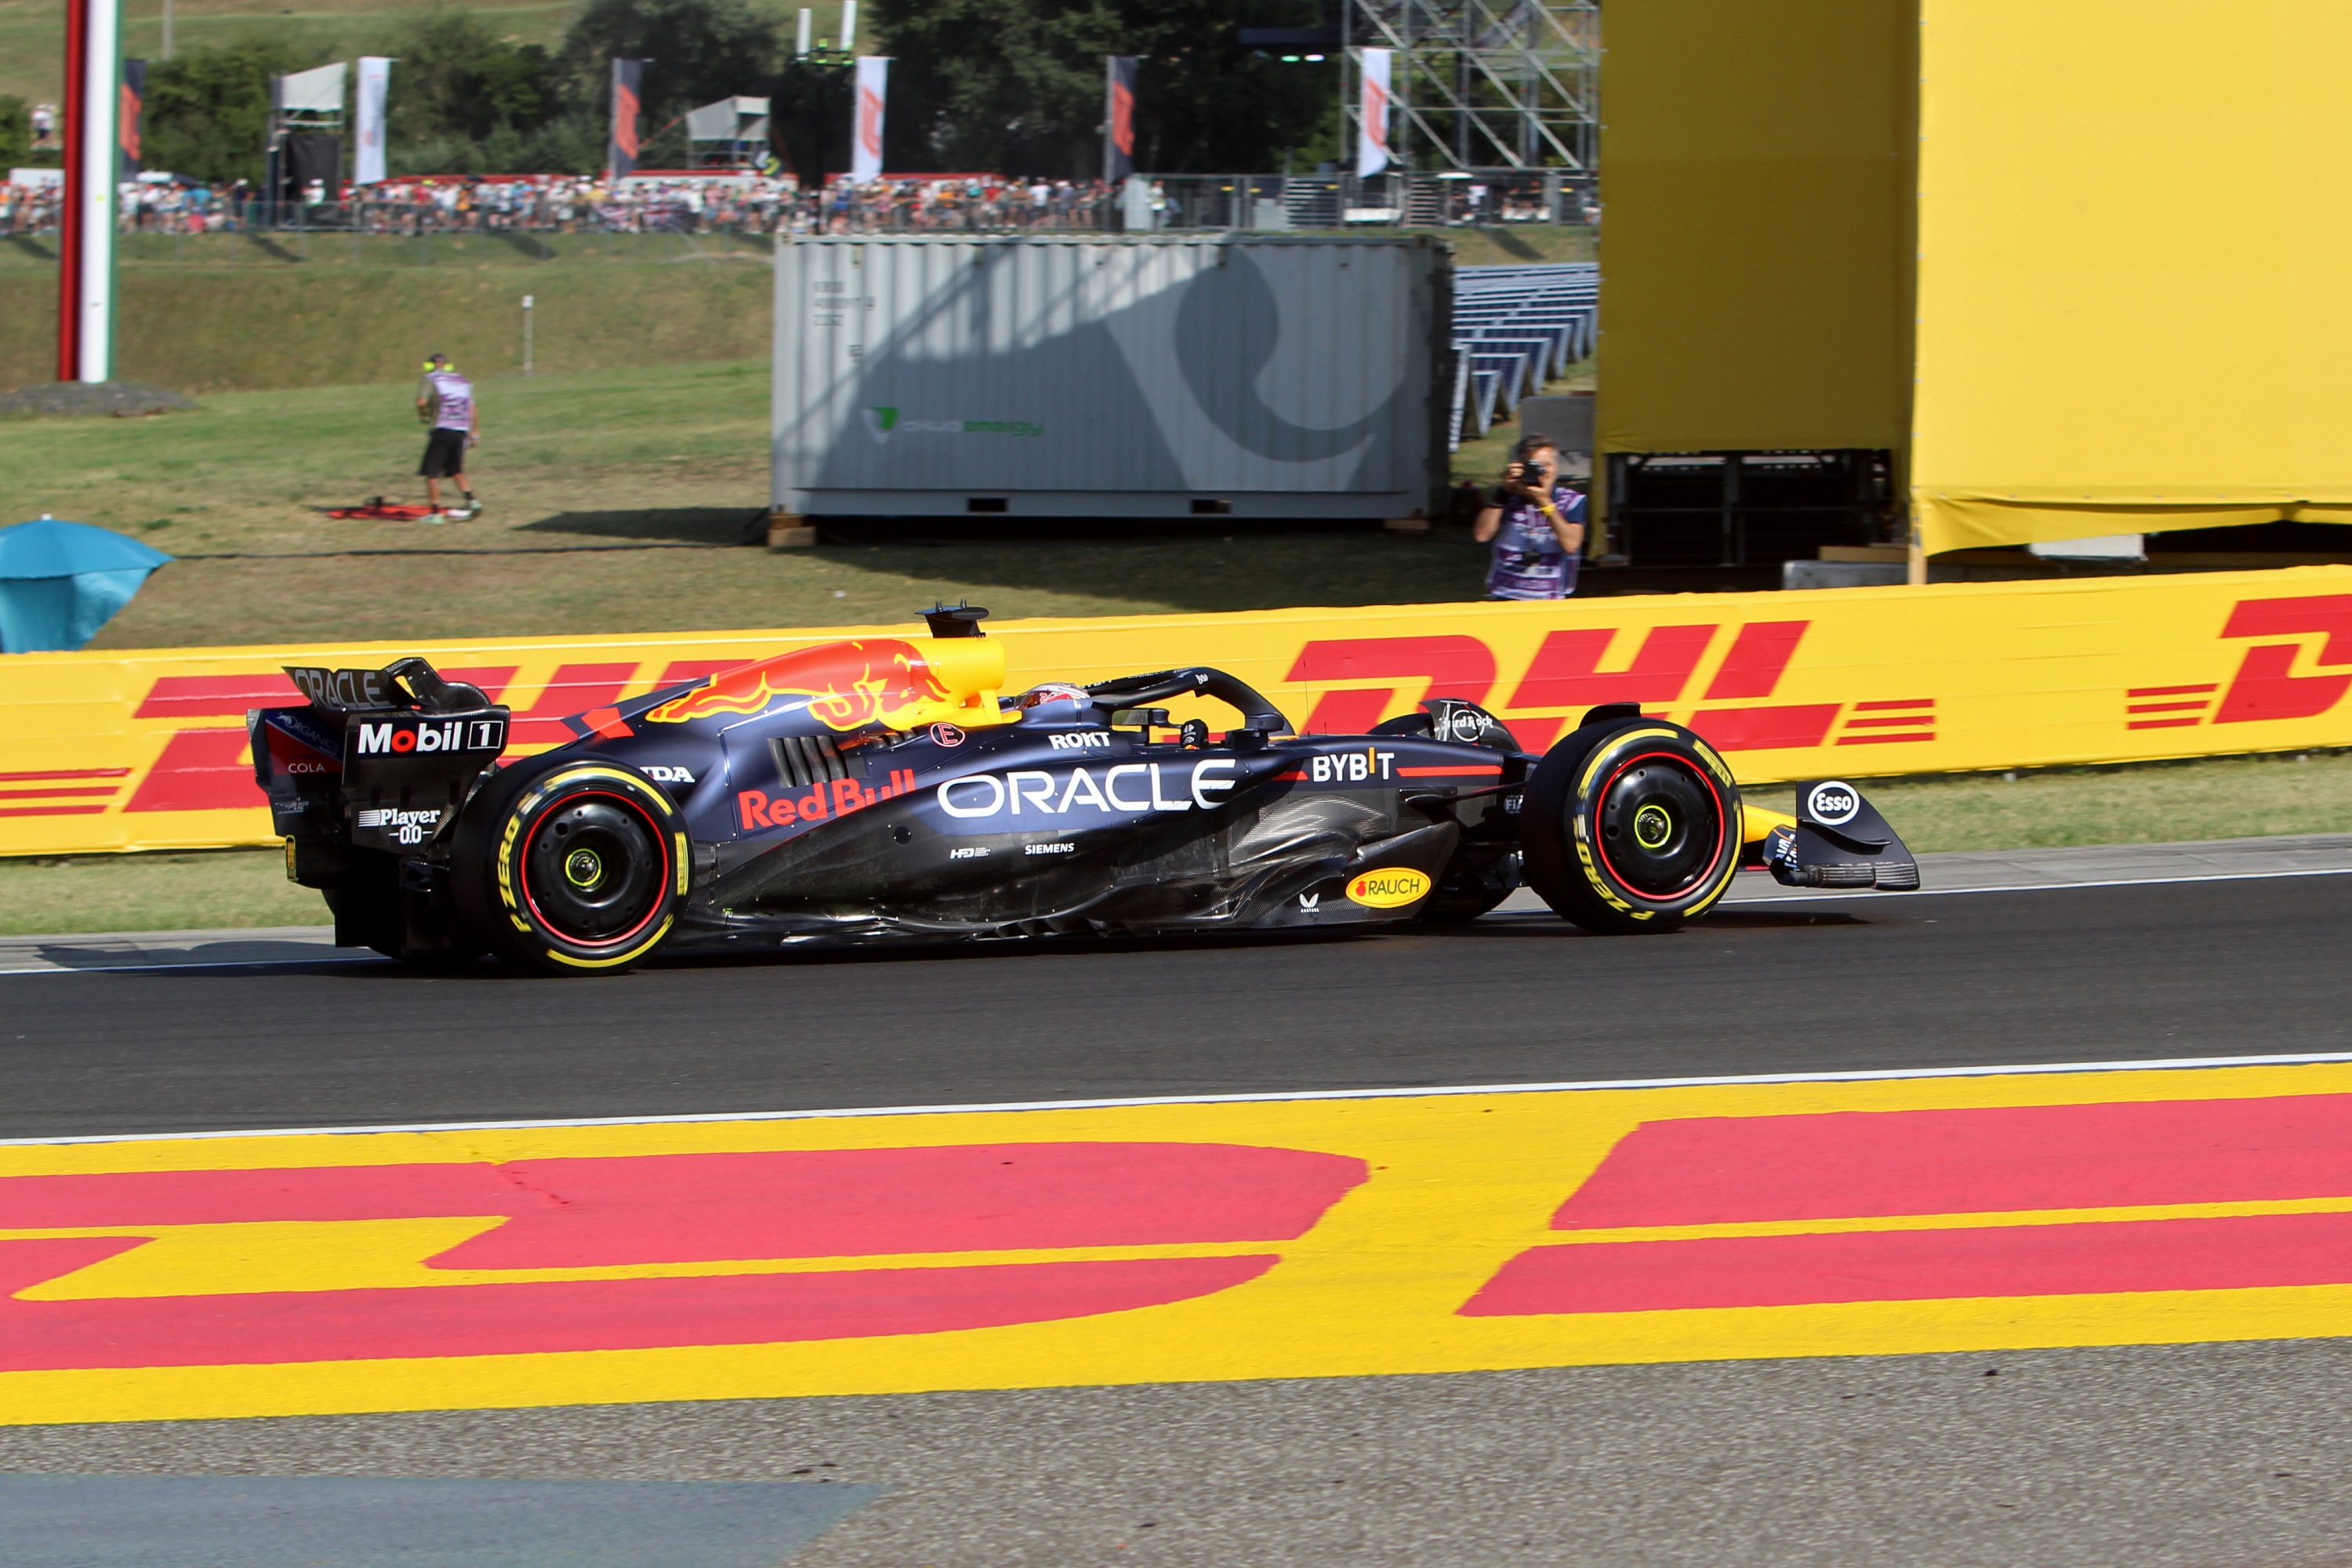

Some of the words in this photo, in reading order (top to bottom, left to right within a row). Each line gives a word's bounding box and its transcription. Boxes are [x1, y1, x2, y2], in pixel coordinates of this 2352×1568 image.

[294, 669, 397, 709] ORACLE
[1467, 714, 1494, 731] Rock
[358, 721, 463, 753] Mobil
[479, 723, 491, 746] 1
[1048, 731, 1110, 750] ROKT
[288, 762, 325, 774] COLA
[1312, 746, 1395, 782] BYBIT
[739, 782, 828, 830] Red
[831, 768, 916, 817] Bull
[937, 758, 1236, 818] ORACLE
[1816, 792, 1853, 812] Esso
[379, 808, 441, 828] Player
[497, 814, 521, 909] ZERO
[1025, 843, 1075, 855] SIEMENS
[1368, 878, 1421, 895] RAUCH
[1575, 840, 1633, 913] ZERO
